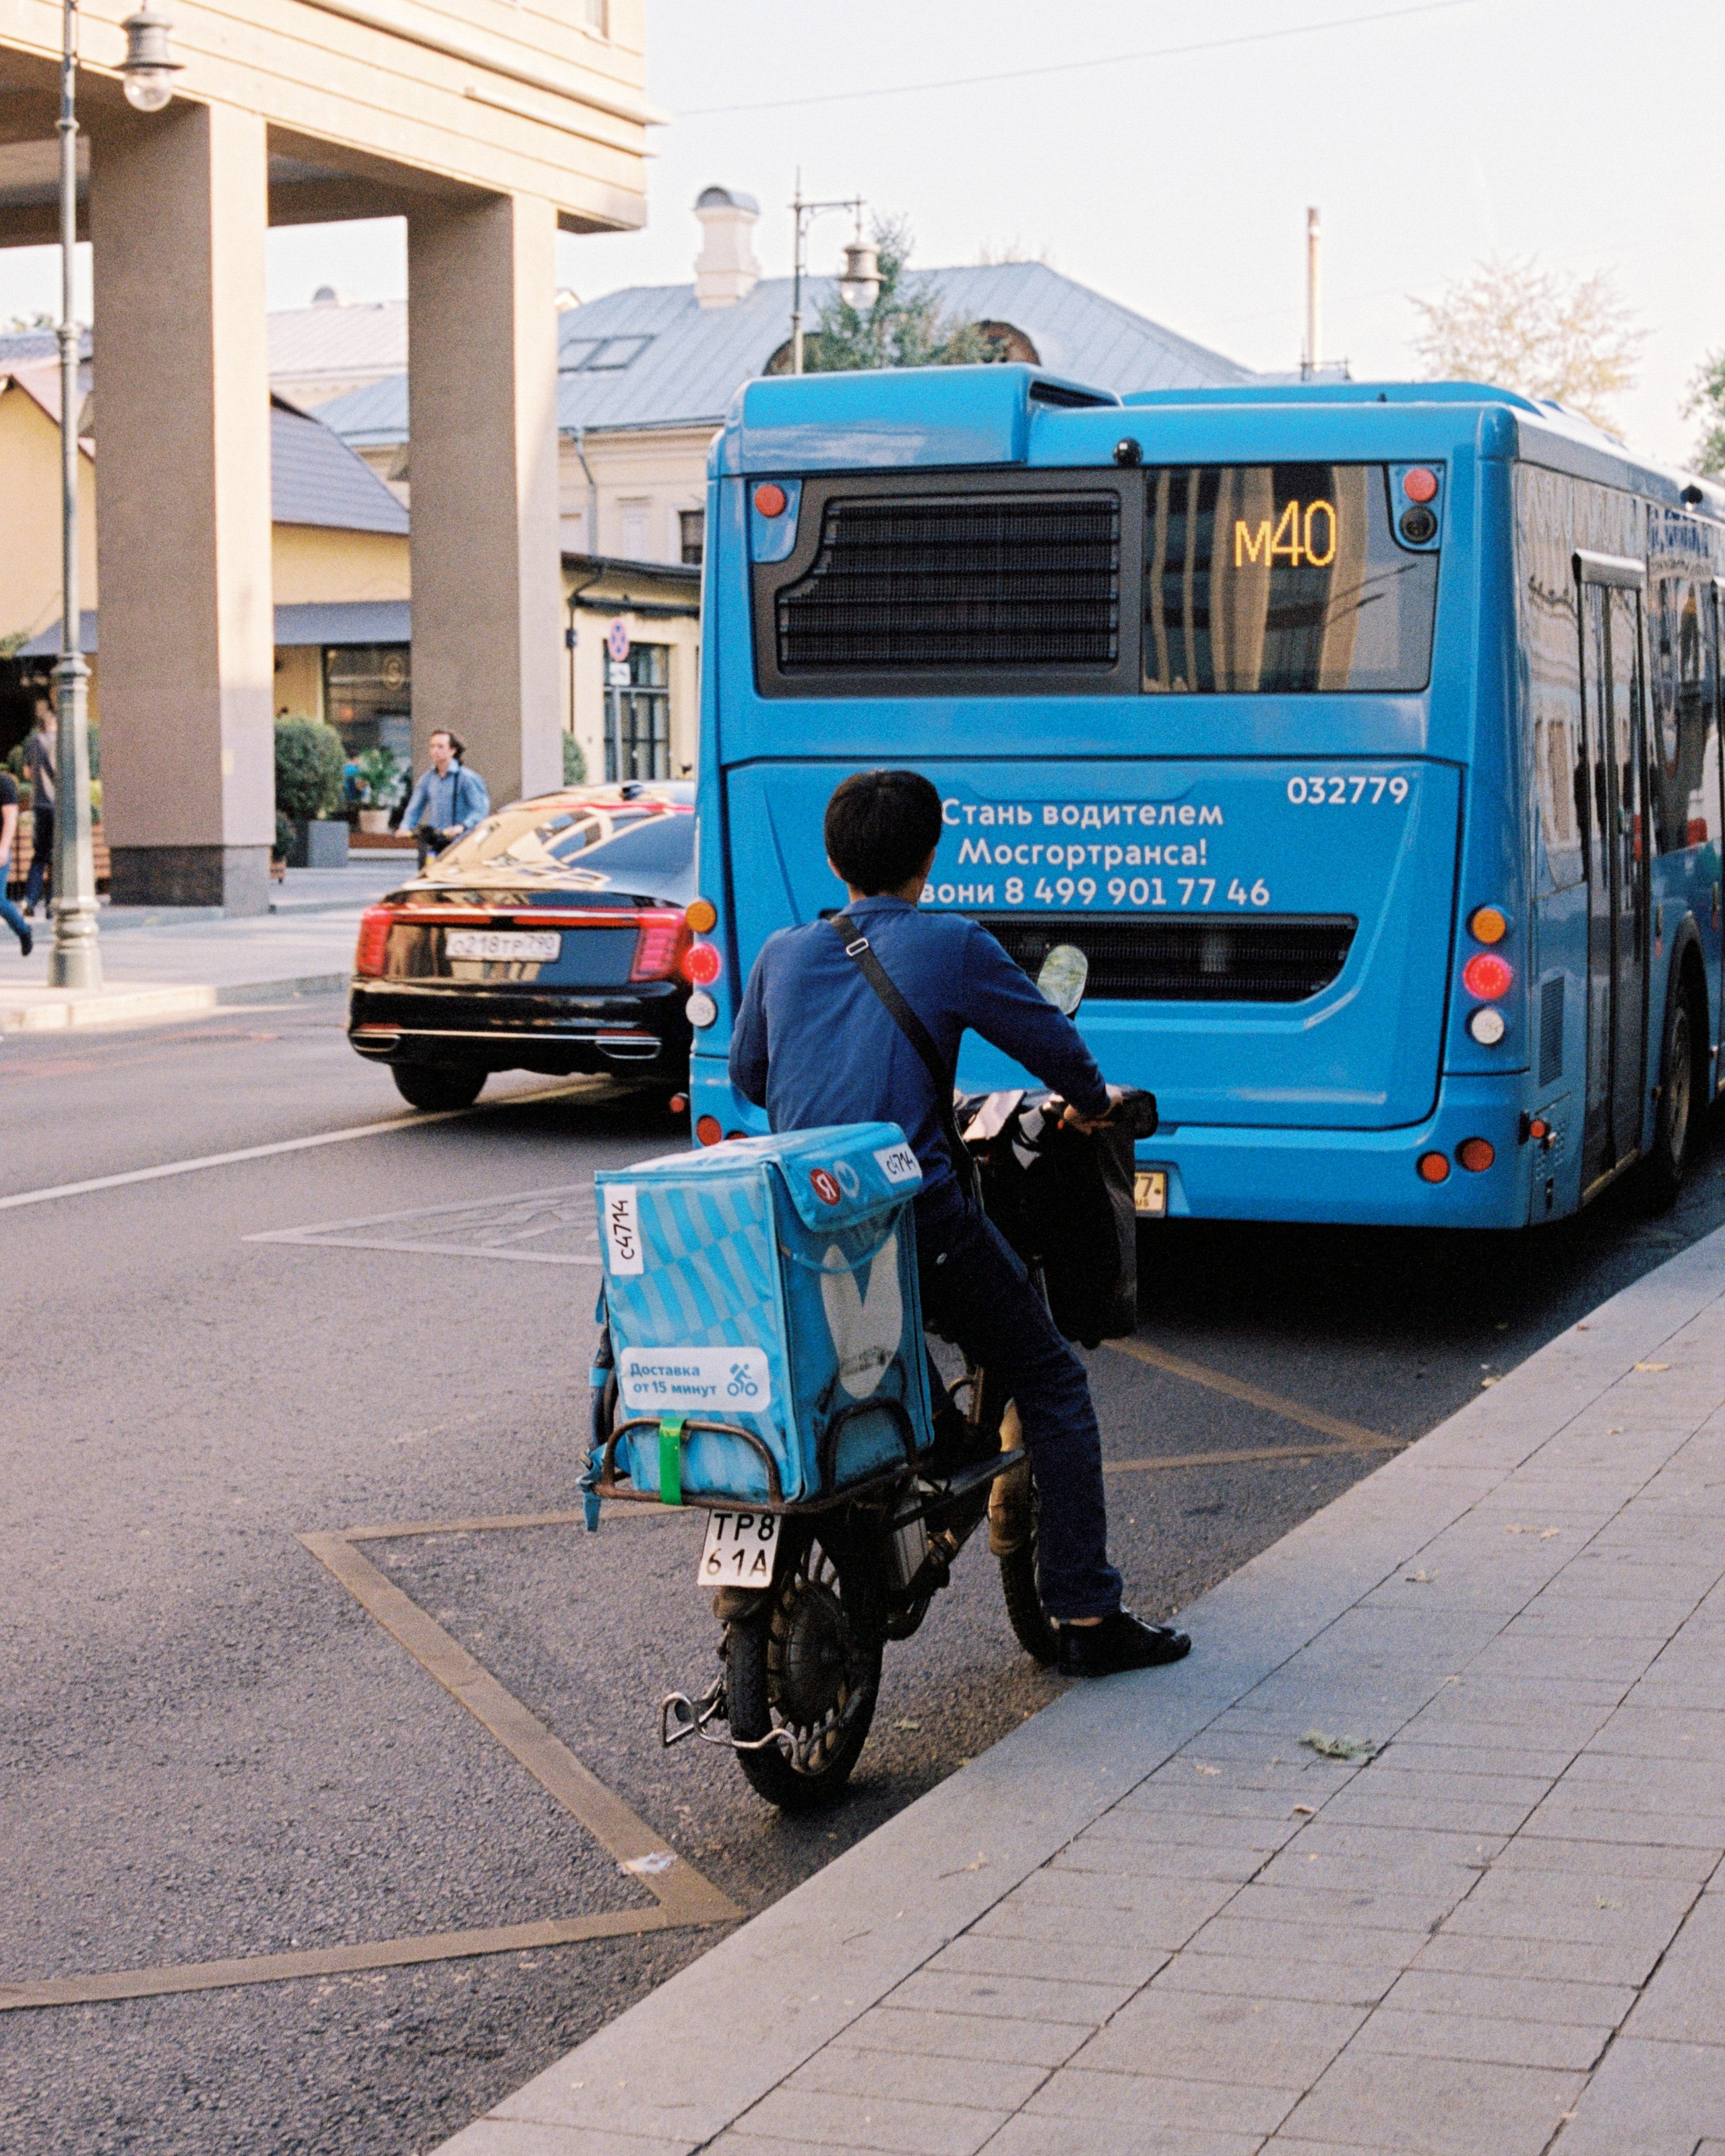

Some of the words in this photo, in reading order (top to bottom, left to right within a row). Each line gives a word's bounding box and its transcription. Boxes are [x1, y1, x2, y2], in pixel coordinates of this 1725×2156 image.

[1234, 500, 1336, 567] М40
[1287, 777, 1408, 804] 032779
[941, 798, 1032, 825] Стань
[1043, 805, 1223, 829] водителем
[958, 838, 1206, 871] Мосгортранса!
[919, 883, 994, 903] вони
[1005, 877, 1024, 904] 8
[1034, 877, 1096, 905] 499
[1107, 878, 1166, 905] 901
[1177, 879, 1216, 905] 77
[1227, 879, 1269, 906] 46
[630, 1362, 701, 1378] Доставка
[633, 1383, 648, 1393] от
[652, 1381, 668, 1394] 15
[671, 1384, 717, 1399] минут
